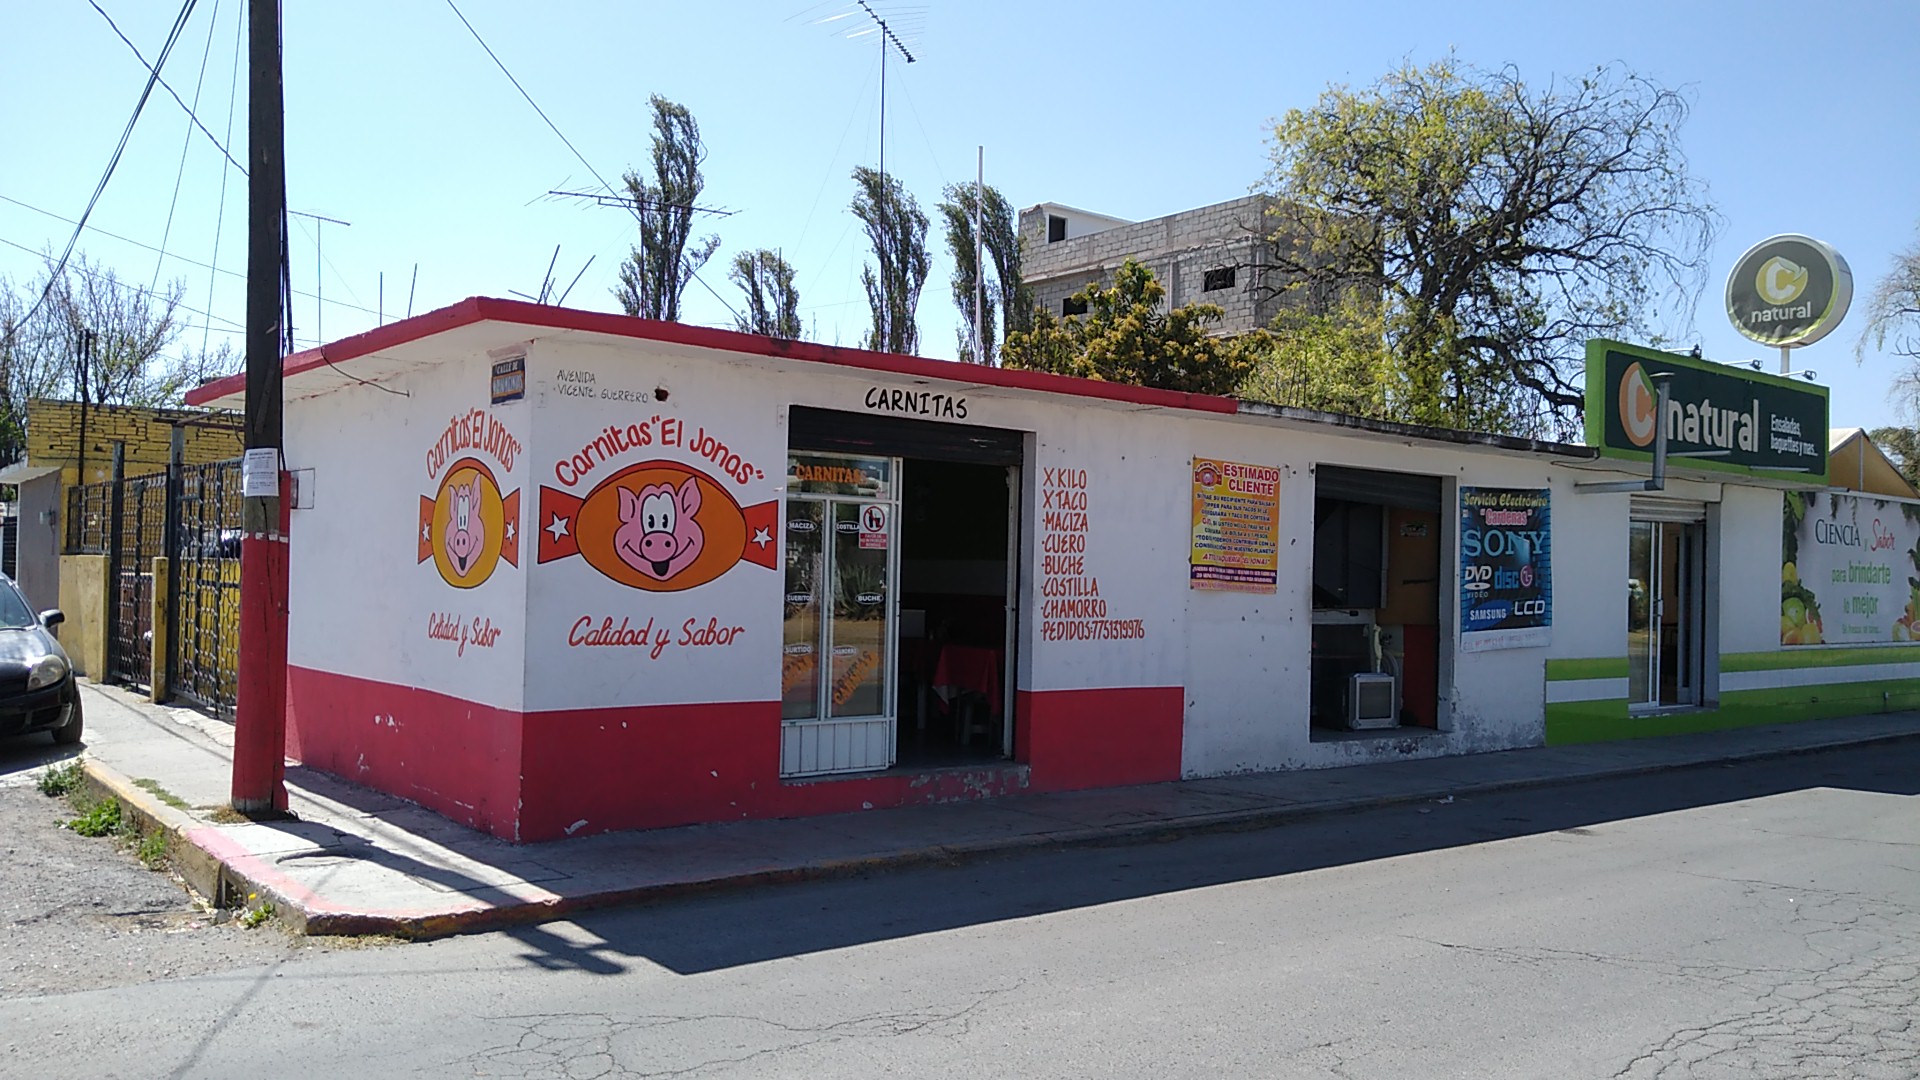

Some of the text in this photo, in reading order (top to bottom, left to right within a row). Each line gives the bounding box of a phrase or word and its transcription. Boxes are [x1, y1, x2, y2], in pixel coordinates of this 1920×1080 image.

[1751, 302, 1811, 323] natural
[557, 369, 596, 384] AVENIDA
[601, 388, 649, 403] GUERRERO
[865, 387, 968, 419] CARNITAS
[1668, 398, 1760, 453] natural
[426, 415, 471, 480] Carnitas
[1771, 432, 1799, 454] baguettes
[555, 421, 652, 487] Carnitas
[796, 464, 863, 484] CARNITAS
[1043, 467, 1087, 490] X KILO
[1223, 464, 1279, 482] ESTIMADO
[1229, 479, 1274, 496] CLIENTE
[1043, 489, 1088, 511] X TACO
[1463, 493, 1497, 506] Servicio
[788, 522, 815, 530] MACIZA
[1045, 511, 1089, 532] MACIZA
[1044, 534, 1085, 553] CUERO
[1463, 529, 1547, 557] SONY
[1815, 519, 1861, 547] CIENCIA
[1870, 518, 1896, 552] Sabor
[1044, 555, 1084, 576] BUCHE
[1464, 565, 1492, 582] DVD
[1848, 560, 1891, 585] brindarte
[1043, 577, 1099, 597] COSTILLA
[1043, 598, 1107, 619] CHAMORRO
[1470, 600, 1546, 621] SAMSUNG LCD
[1852, 592, 1879, 619] mejor
[458, 624, 468, 658] y
[470, 616, 502, 648] Sabor
[568, 615, 746, 660] Calidad y Sabor
